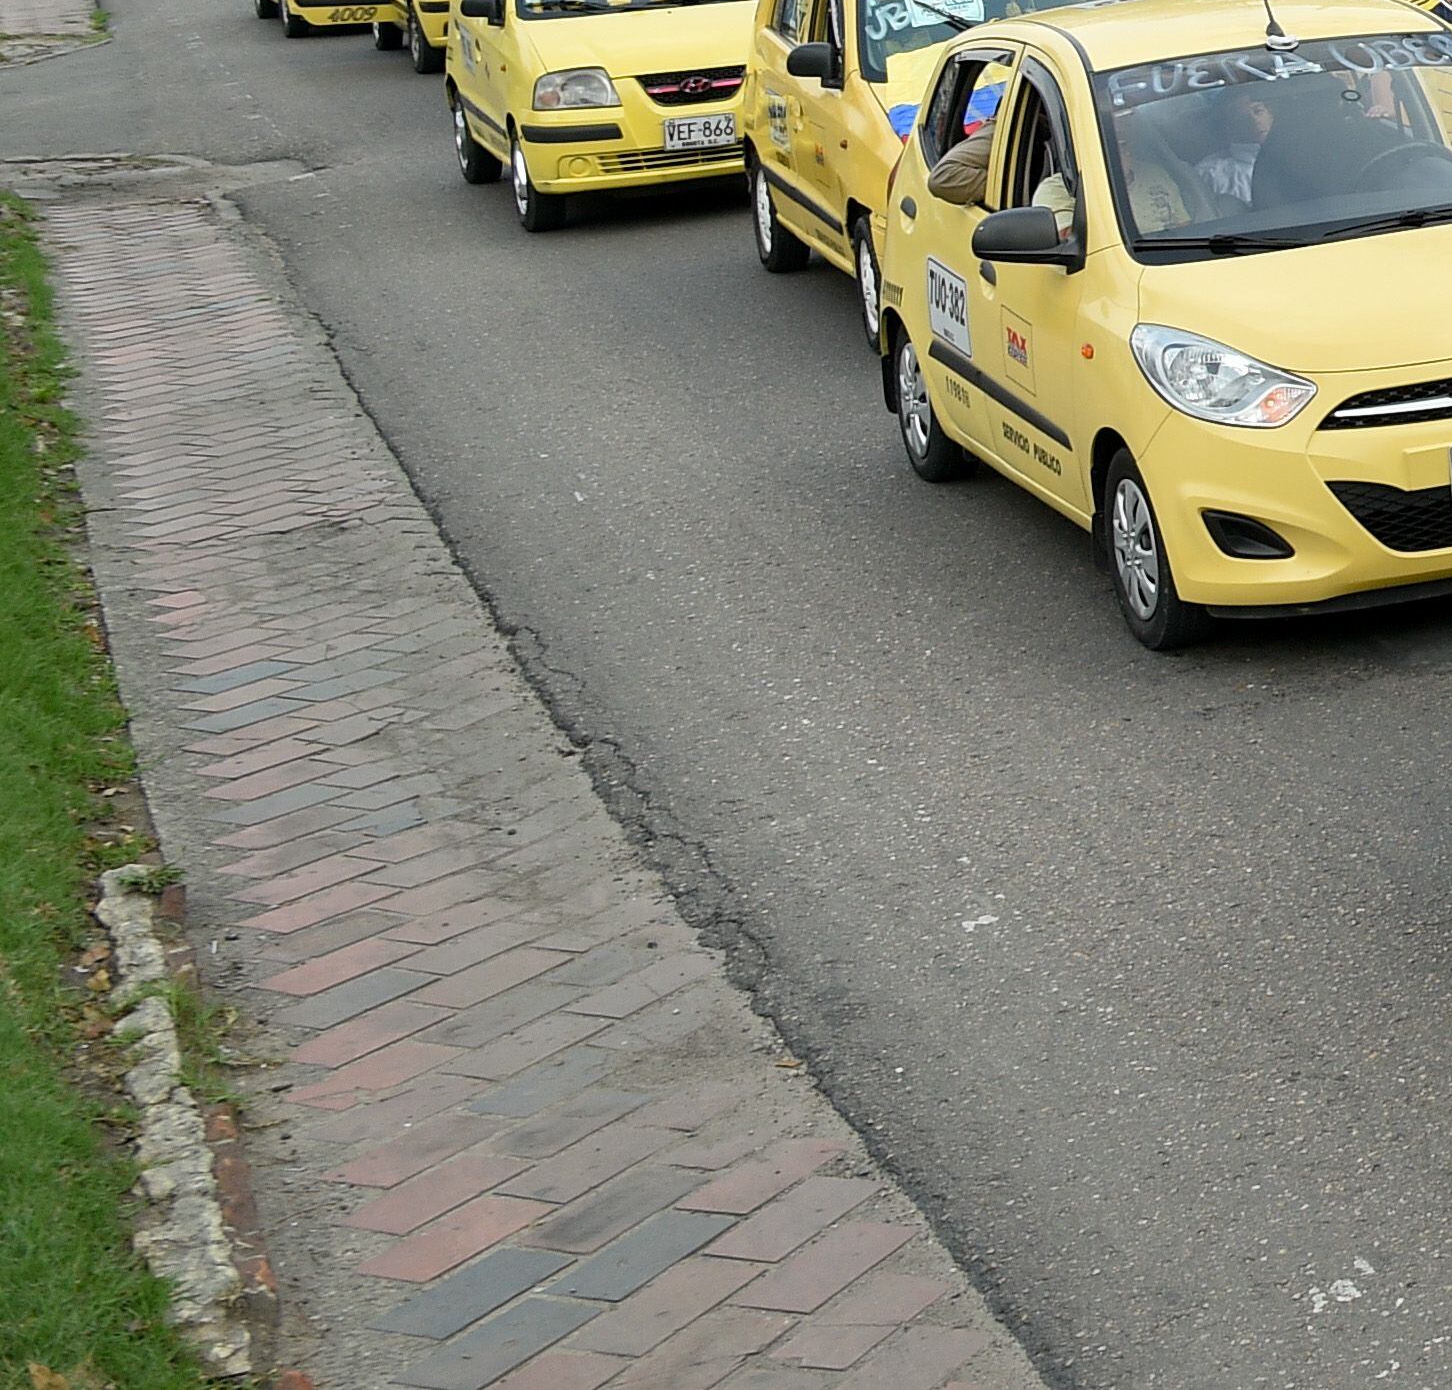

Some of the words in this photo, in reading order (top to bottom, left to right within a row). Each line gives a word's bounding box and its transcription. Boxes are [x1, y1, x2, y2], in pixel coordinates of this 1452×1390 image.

[1107, 50, 1325, 107] FUERA
[1006, 326, 1028, 356] TAX
[1002, 421, 1030, 455] SERVICIO
[1033, 442, 1062, 477] PUBLICO
